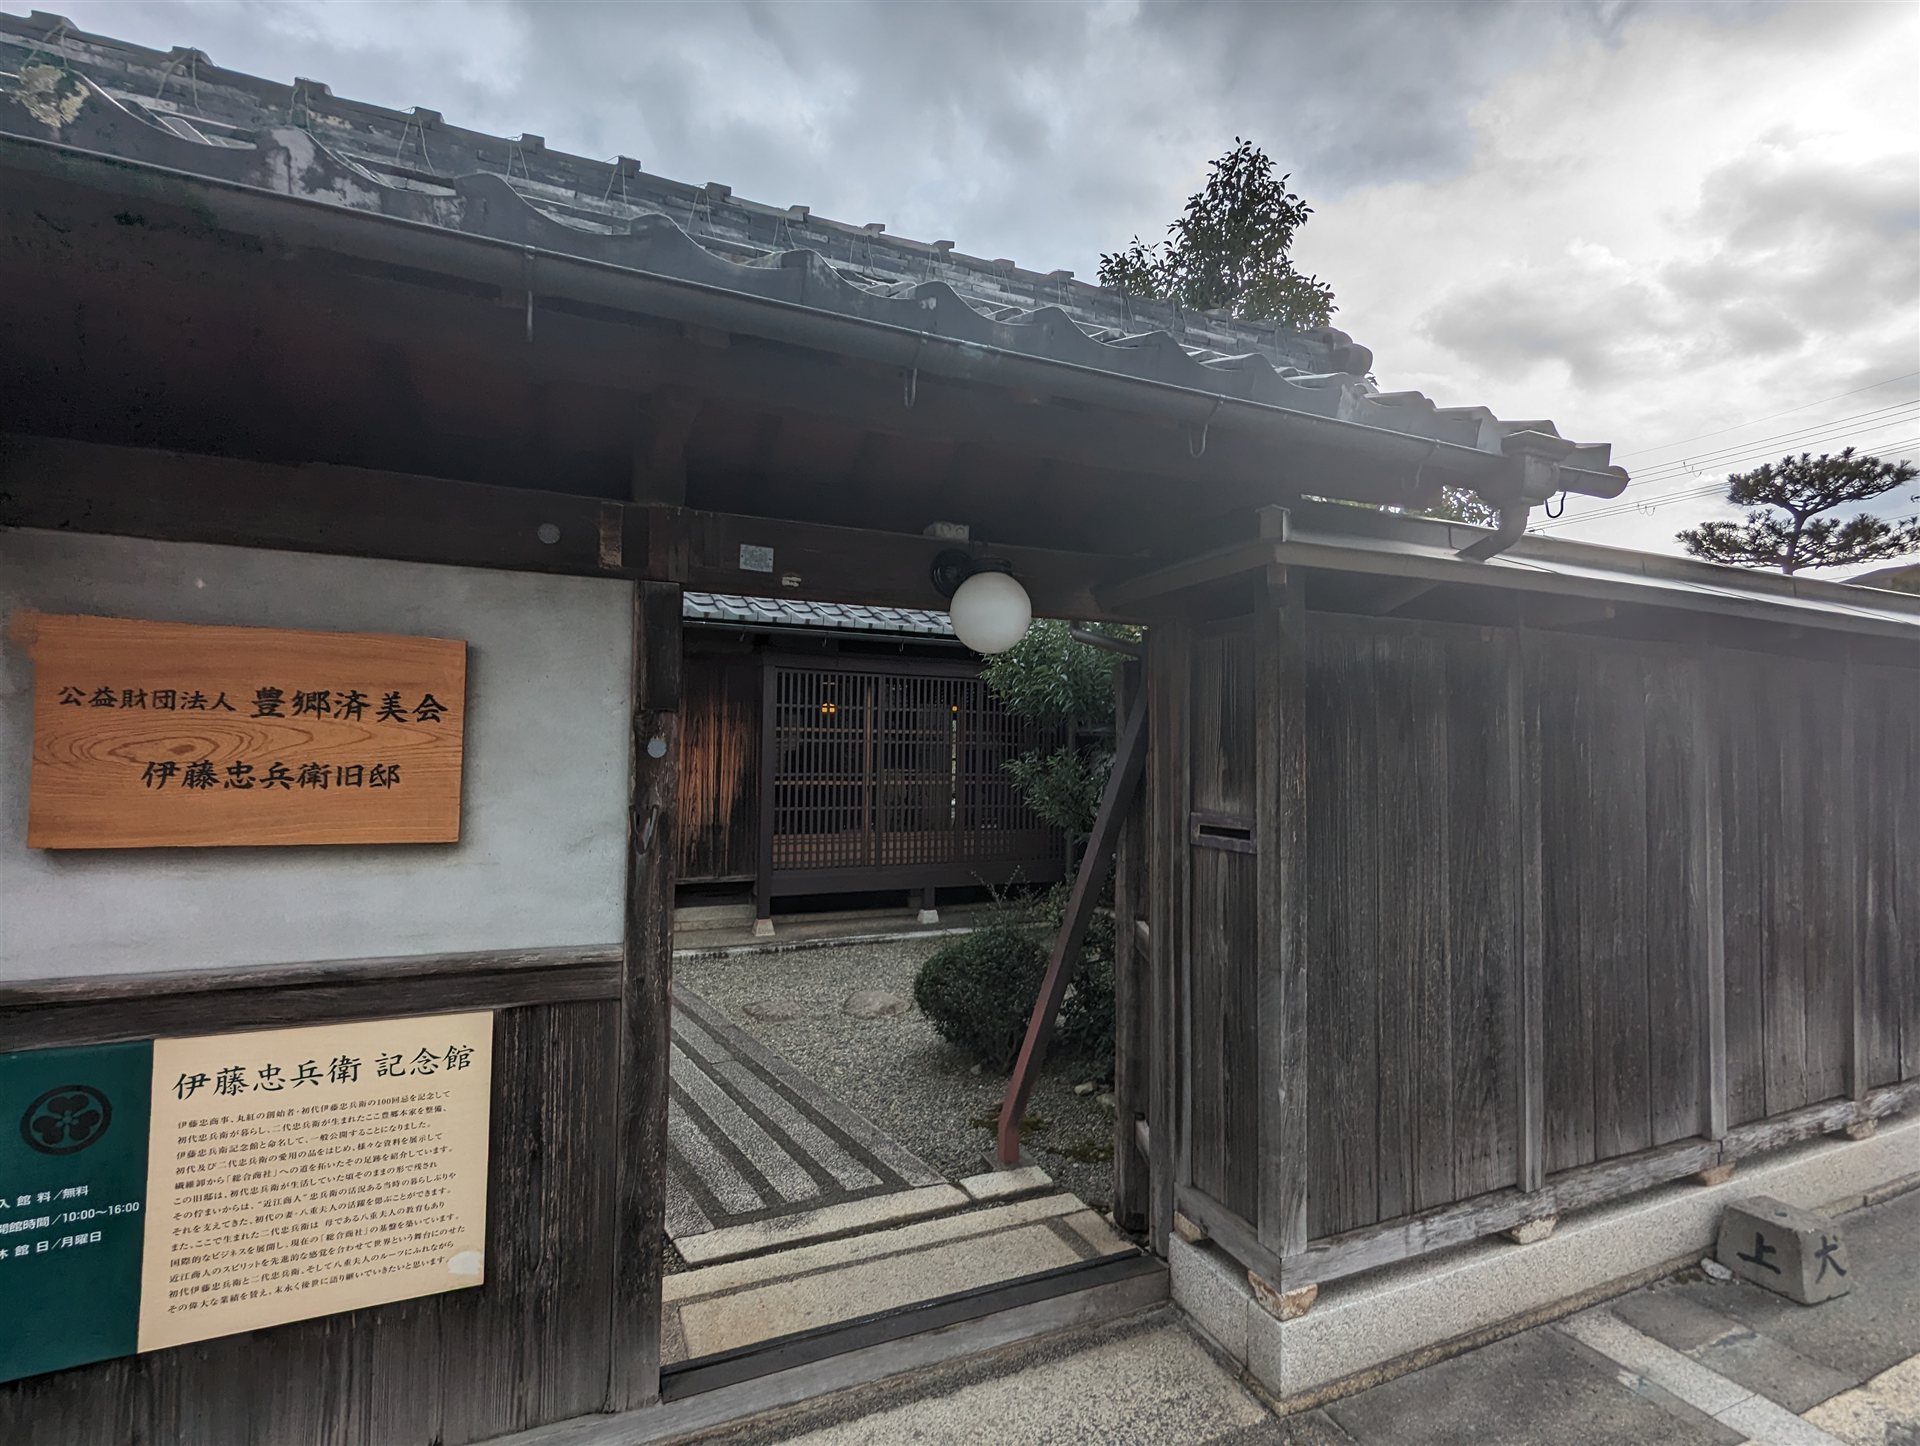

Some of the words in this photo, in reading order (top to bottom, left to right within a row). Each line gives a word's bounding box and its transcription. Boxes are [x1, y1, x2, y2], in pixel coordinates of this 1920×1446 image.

[57, 685, 237, 712] 公益財団法人
[250, 686, 449, 723] 豊郷済美会
[140, 760, 401, 791] 伊藤忠兵衛旧邸
[171, 1057, 363, 1100] 伊藤忠兵衛
[375, 1044, 476, 1078] 記念館
[1736, 1231, 1781, 1275] 上
